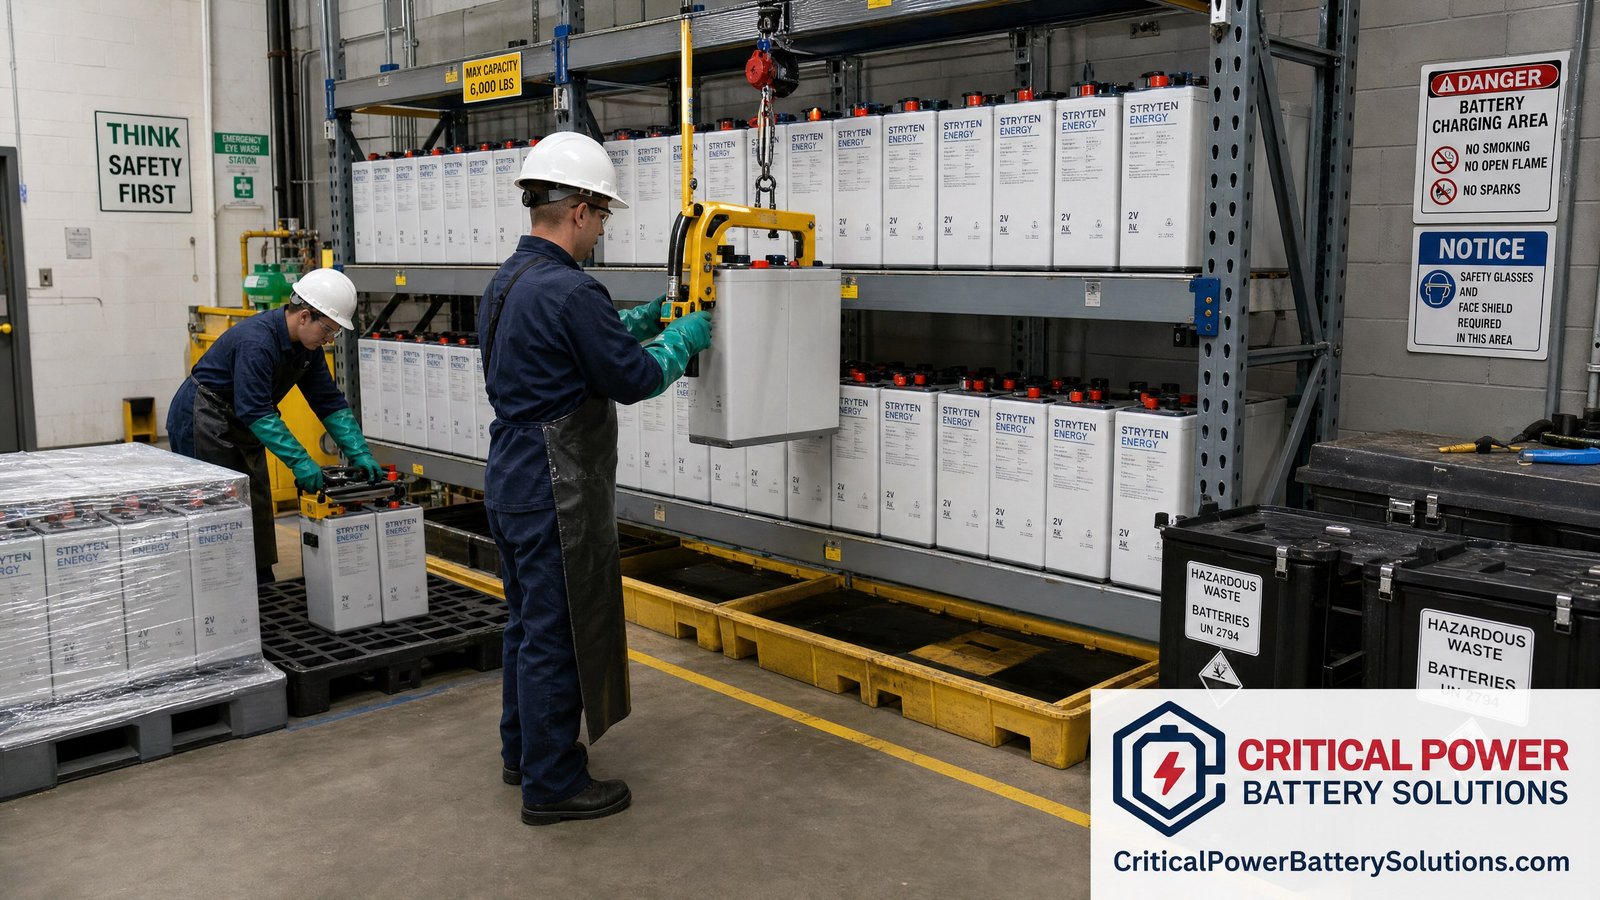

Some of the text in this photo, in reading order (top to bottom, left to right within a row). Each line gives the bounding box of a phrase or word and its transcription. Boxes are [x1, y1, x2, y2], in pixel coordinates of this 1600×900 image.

[466, 60, 518, 78] MAX CAPACITY
[1458, 69, 1541, 92] DANGER
[470, 78, 514, 96] 6,000 LBS
[1130, 101, 1178, 114] STRYTEN
[1460, 96, 1525, 114] BATTERY
[1000, 114, 1041, 125] STRYTEN
[1062, 109, 1106, 120] STRYTEN
[1130, 113, 1168, 124] ENERGY
[944, 120, 982, 130] STRYTEN
[1062, 120, 1097, 130] ENERGY
[1433, 113, 1548, 133] CHARGING AREA
[838, 129, 871, 138] STRYTEN
[888, 124, 924, 134] STRYTEN
[944, 130, 974, 139] ENERGY
[1000, 126, 1032, 135] ENERGY
[107, 123, 180, 148] THINK
[222, 135, 261, 144] EMERGENCY
[792, 133, 823, 142] STRYTEN
[888, 134, 917, 143] ENERGY
[838, 139, 864, 147] ENERGY
[1466, 141, 1530, 154] NO SMOKING
[240, 145, 260, 153] WASH
[229, 156, 256, 164] STATION
[1465, 157, 1547, 172] NO OPEN FLAME
[109, 155, 182, 177] SAFETY
[119, 184, 175, 204] FIRST
[1464, 183, 1521, 196] NO SPARKS
[1439, 238, 1525, 260] NOTICE
[1461, 272, 1533, 282] SAFETY GLASSES
[1460, 287, 1478, 297] AND
[1459, 302, 1513, 314] FACE SHIELD
[1458, 318, 1501, 328] REQUIRED
[1457, 333, 1512, 345] IN THIS AREA
[840, 397, 868, 407] TRYTEN
[885, 402, 921, 412] STRYTEN
[840, 407, 861, 415] NERGY
[885, 412, 913, 421] ENERGY
[943, 407, 980, 418] STRYTEN
[943, 416, 972, 426] ENERGY
[996, 413, 1035, 424] STRYTEN
[996, 423, 1027, 433] ENERGY
[1054, 419, 1096, 432] STRYTEN
[1054, 430, 1088, 440] ENERGY
[1122, 426, 1168, 439] STRYTEN
[1122, 437, 1158, 448] ENERGY
[199, 521, 242, 534] STRYTEN
[386, 518, 417, 528] STRYTEN
[336, 524, 369, 534] STRYTEN
[386, 526, 411, 535] ENERGY
[132, 531, 179, 544] STRYTEN
[199, 533, 233, 544] ENERGY
[337, 533, 363, 542] ENERGY
[56, 542, 109, 555] STRYTEN
[132, 543, 170, 554] ENERGY
[0, 552, 31, 564] YTEN
[58, 553, 99, 566] ENERGY
[0, 565, 20, 575] RGY
[1192, 568, 1256, 592] HAZARDOUS
[1204, 584, 1240, 602] WASTE
[205, 616, 214, 624] 2V
[1192, 605, 1249, 628] BATTERIES
[138, 629, 148, 638] 2V
[1201, 623, 1239, 641] UN 2794
[1428, 618, 1526, 648] HAZARDOUS
[1448, 638, 1503, 661] WASTE
[1428, 661, 1516, 690] BATTERIES
